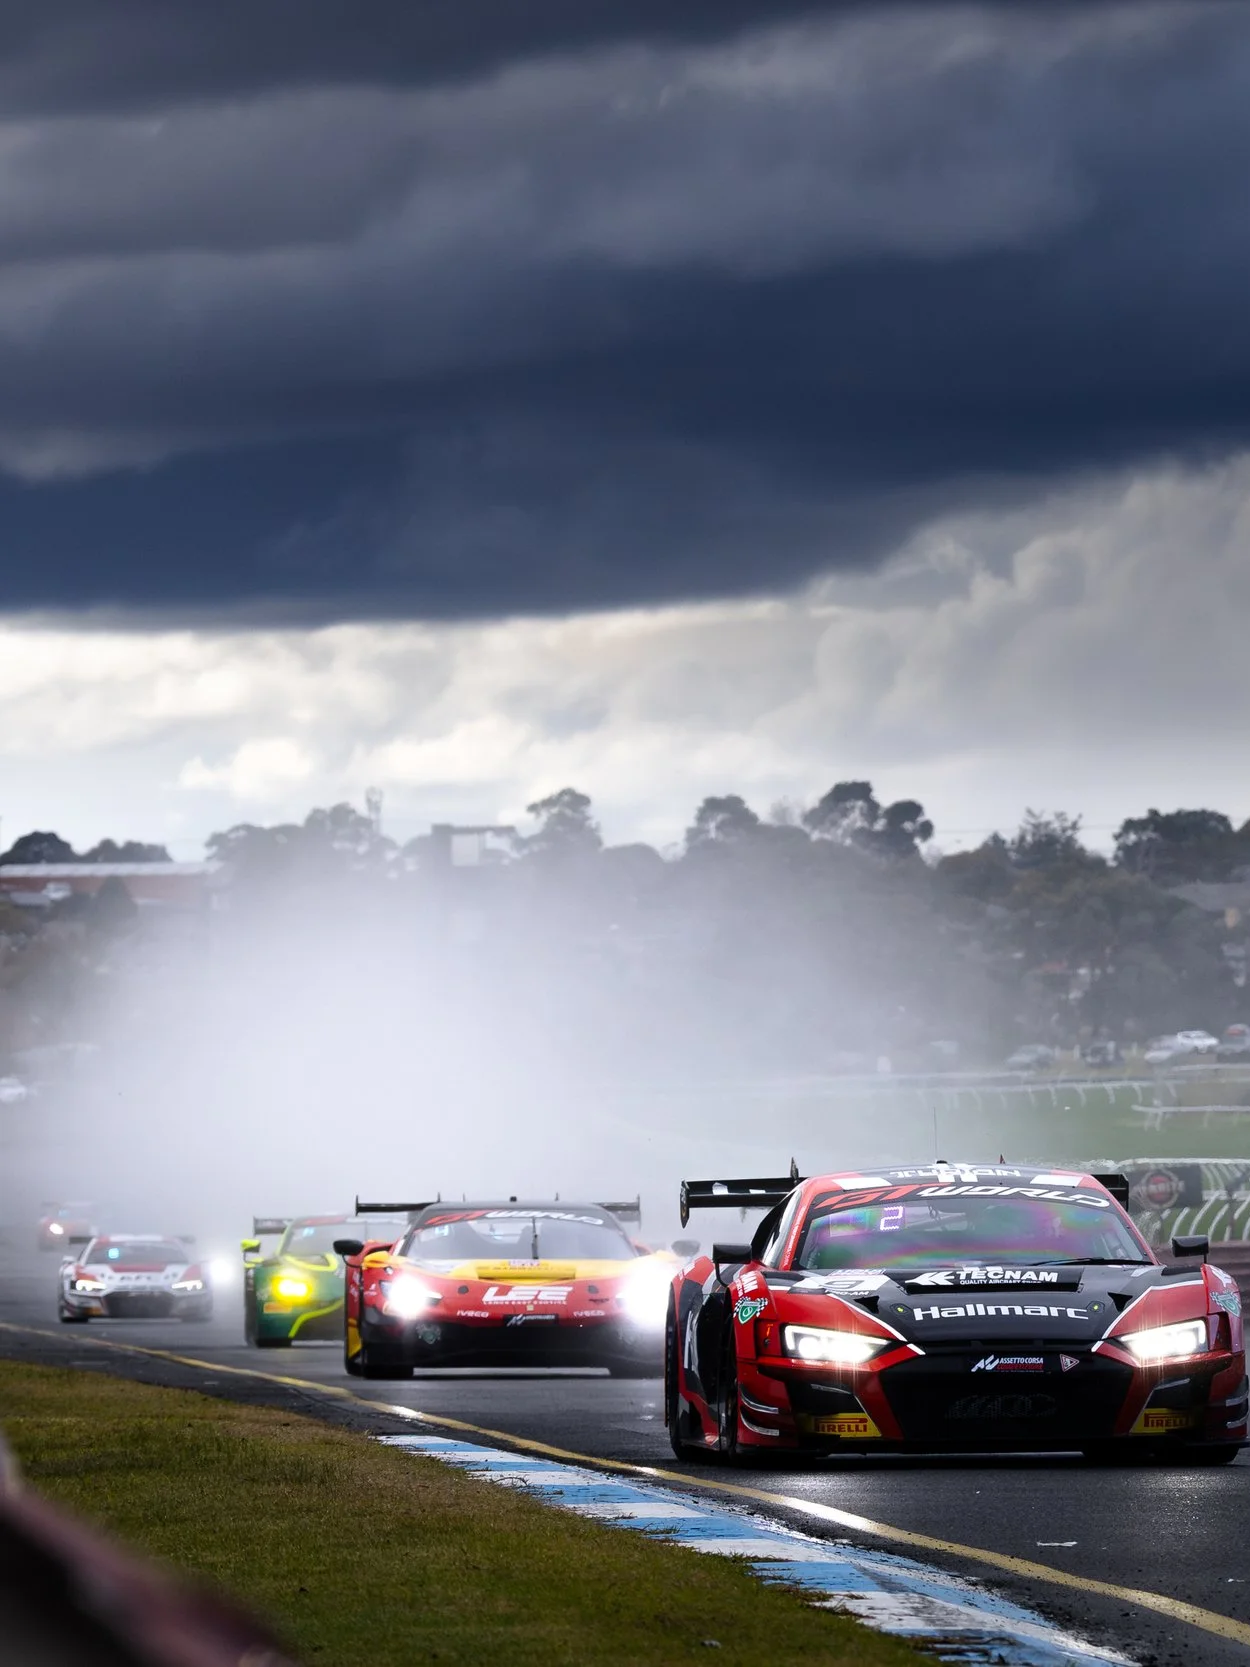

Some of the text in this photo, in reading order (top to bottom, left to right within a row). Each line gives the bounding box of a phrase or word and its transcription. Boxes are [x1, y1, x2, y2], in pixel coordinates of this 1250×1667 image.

[814, 1181, 1110, 1209] GT WORLD
[880, 1206, 903, 1231] 2
[956, 1270, 1059, 1283] TECNAM
[482, 1286, 573, 1302] LEE
[456, 1309, 489, 1318] IVECO
[913, 1303, 1089, 1321] Hallmarc
[814, 1417, 868, 1433] PIRELLI
